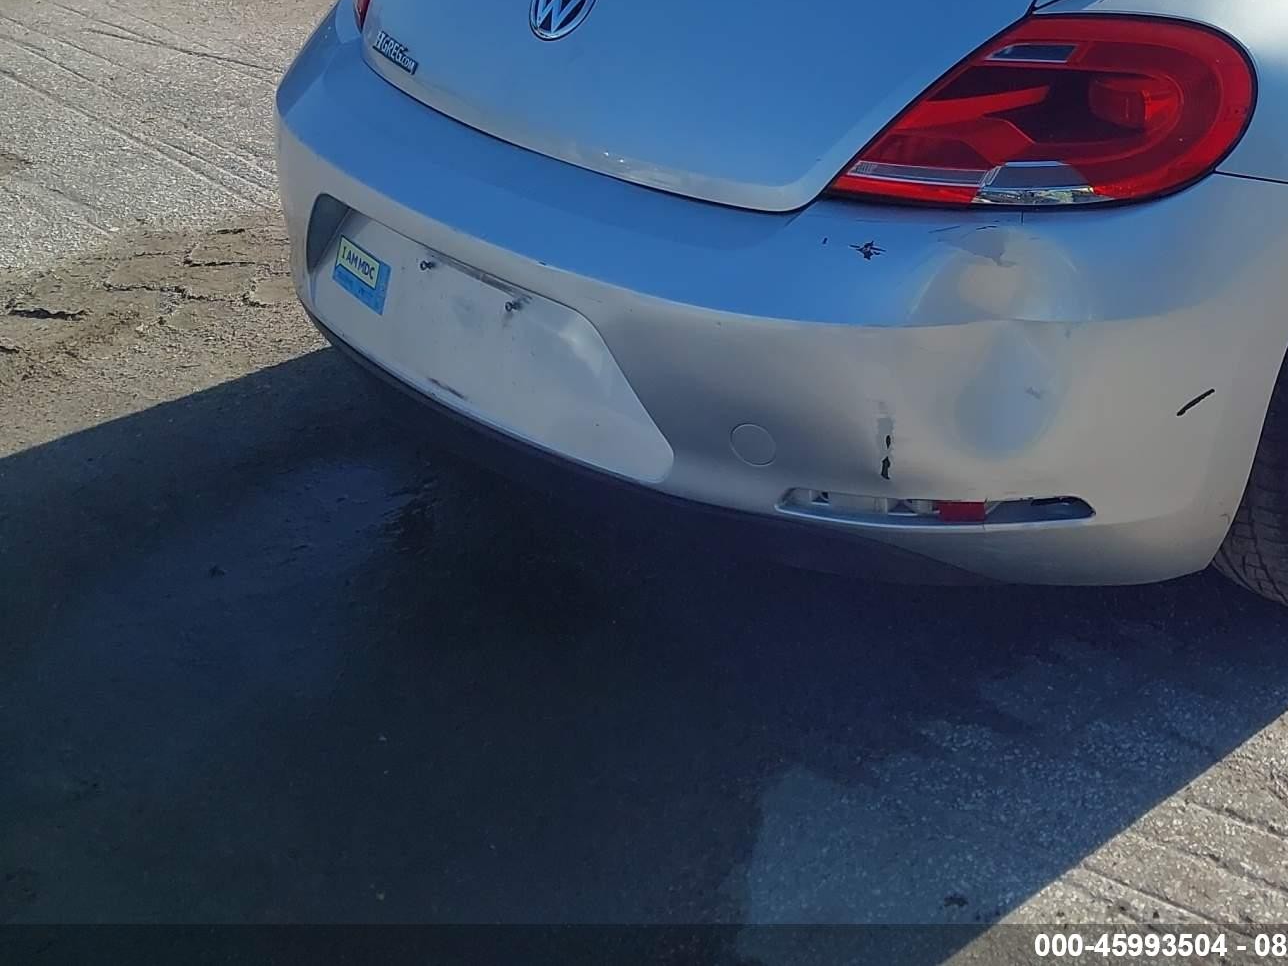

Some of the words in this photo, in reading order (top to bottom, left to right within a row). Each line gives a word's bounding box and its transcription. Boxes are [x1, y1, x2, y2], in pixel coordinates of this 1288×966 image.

[342, 245, 347, 259] I
[346, 249, 359, 269] AM
[357, 257, 376, 281] MDC
